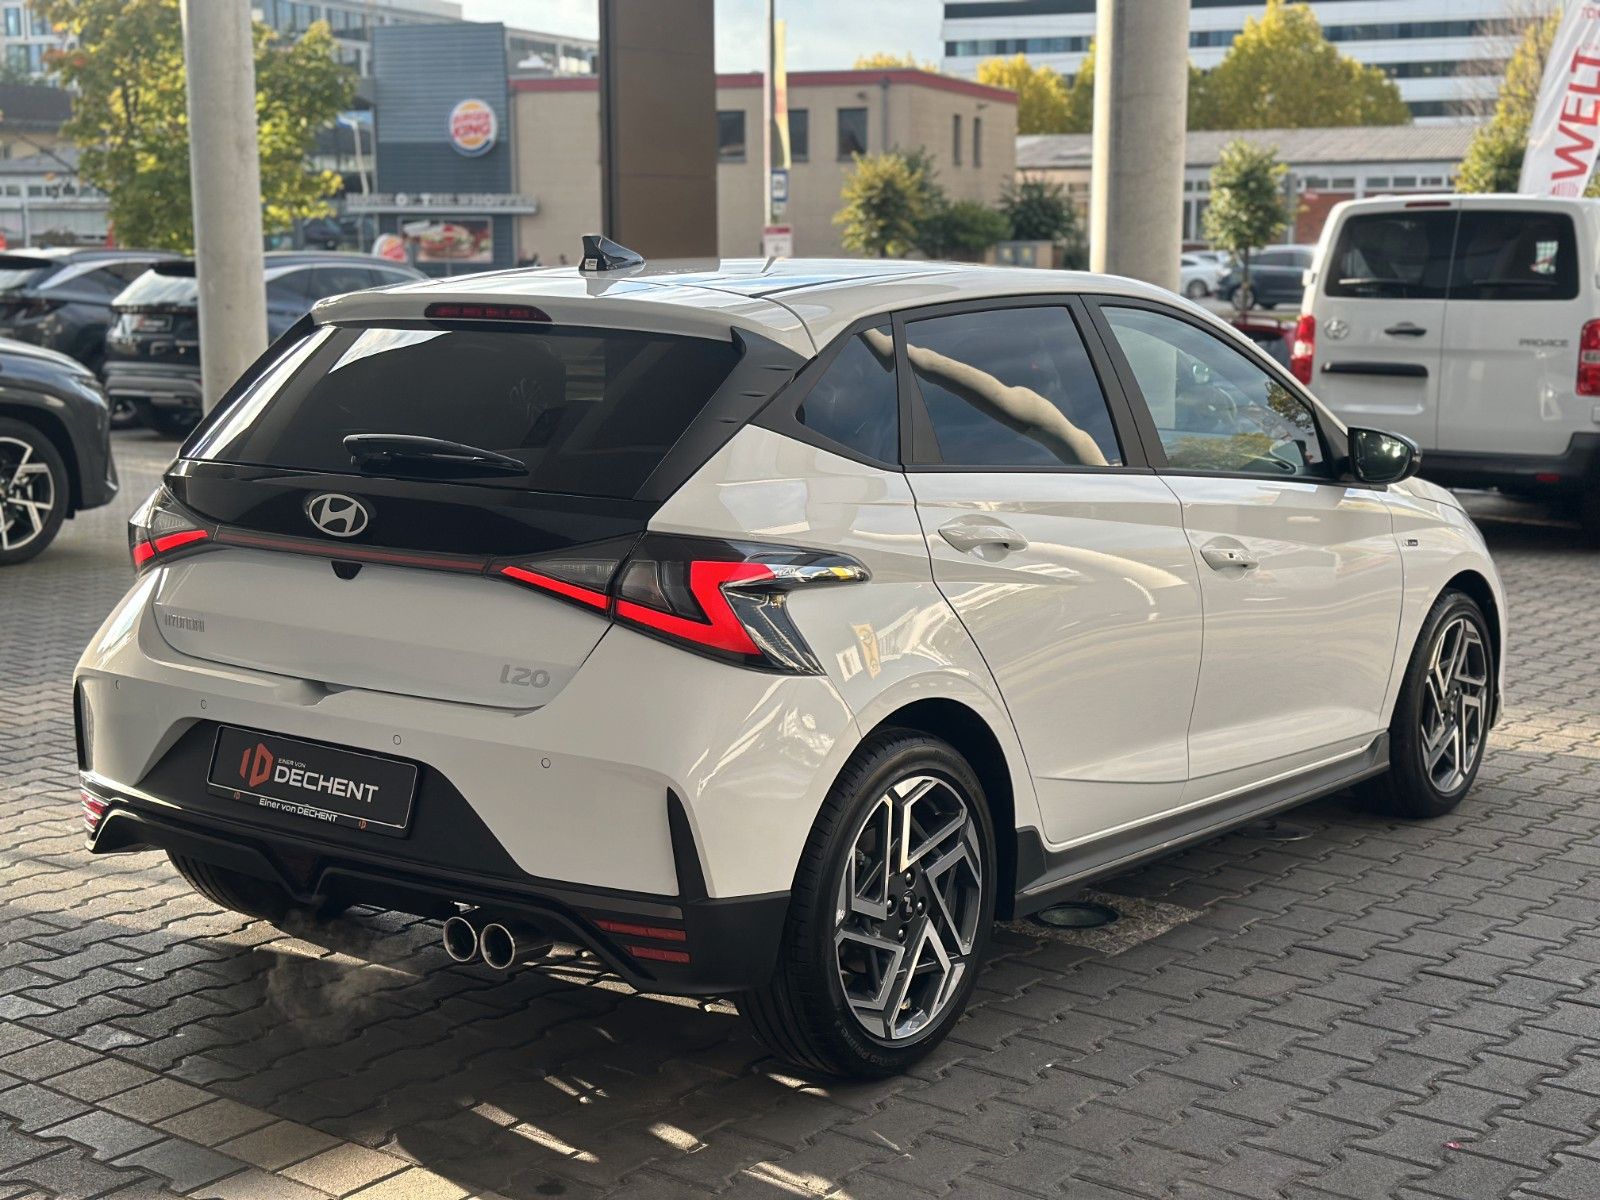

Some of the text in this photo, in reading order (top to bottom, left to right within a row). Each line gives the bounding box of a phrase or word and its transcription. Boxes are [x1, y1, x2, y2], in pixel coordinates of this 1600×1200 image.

[1551, 48, 1600, 180] WELT
[278, 757, 306, 769] EINER VON
[273, 765, 379, 803] DECHENT
[259, 797, 281, 809] Einer
[281, 803, 296, 813] von
[296, 806, 338, 822] DECHENT
